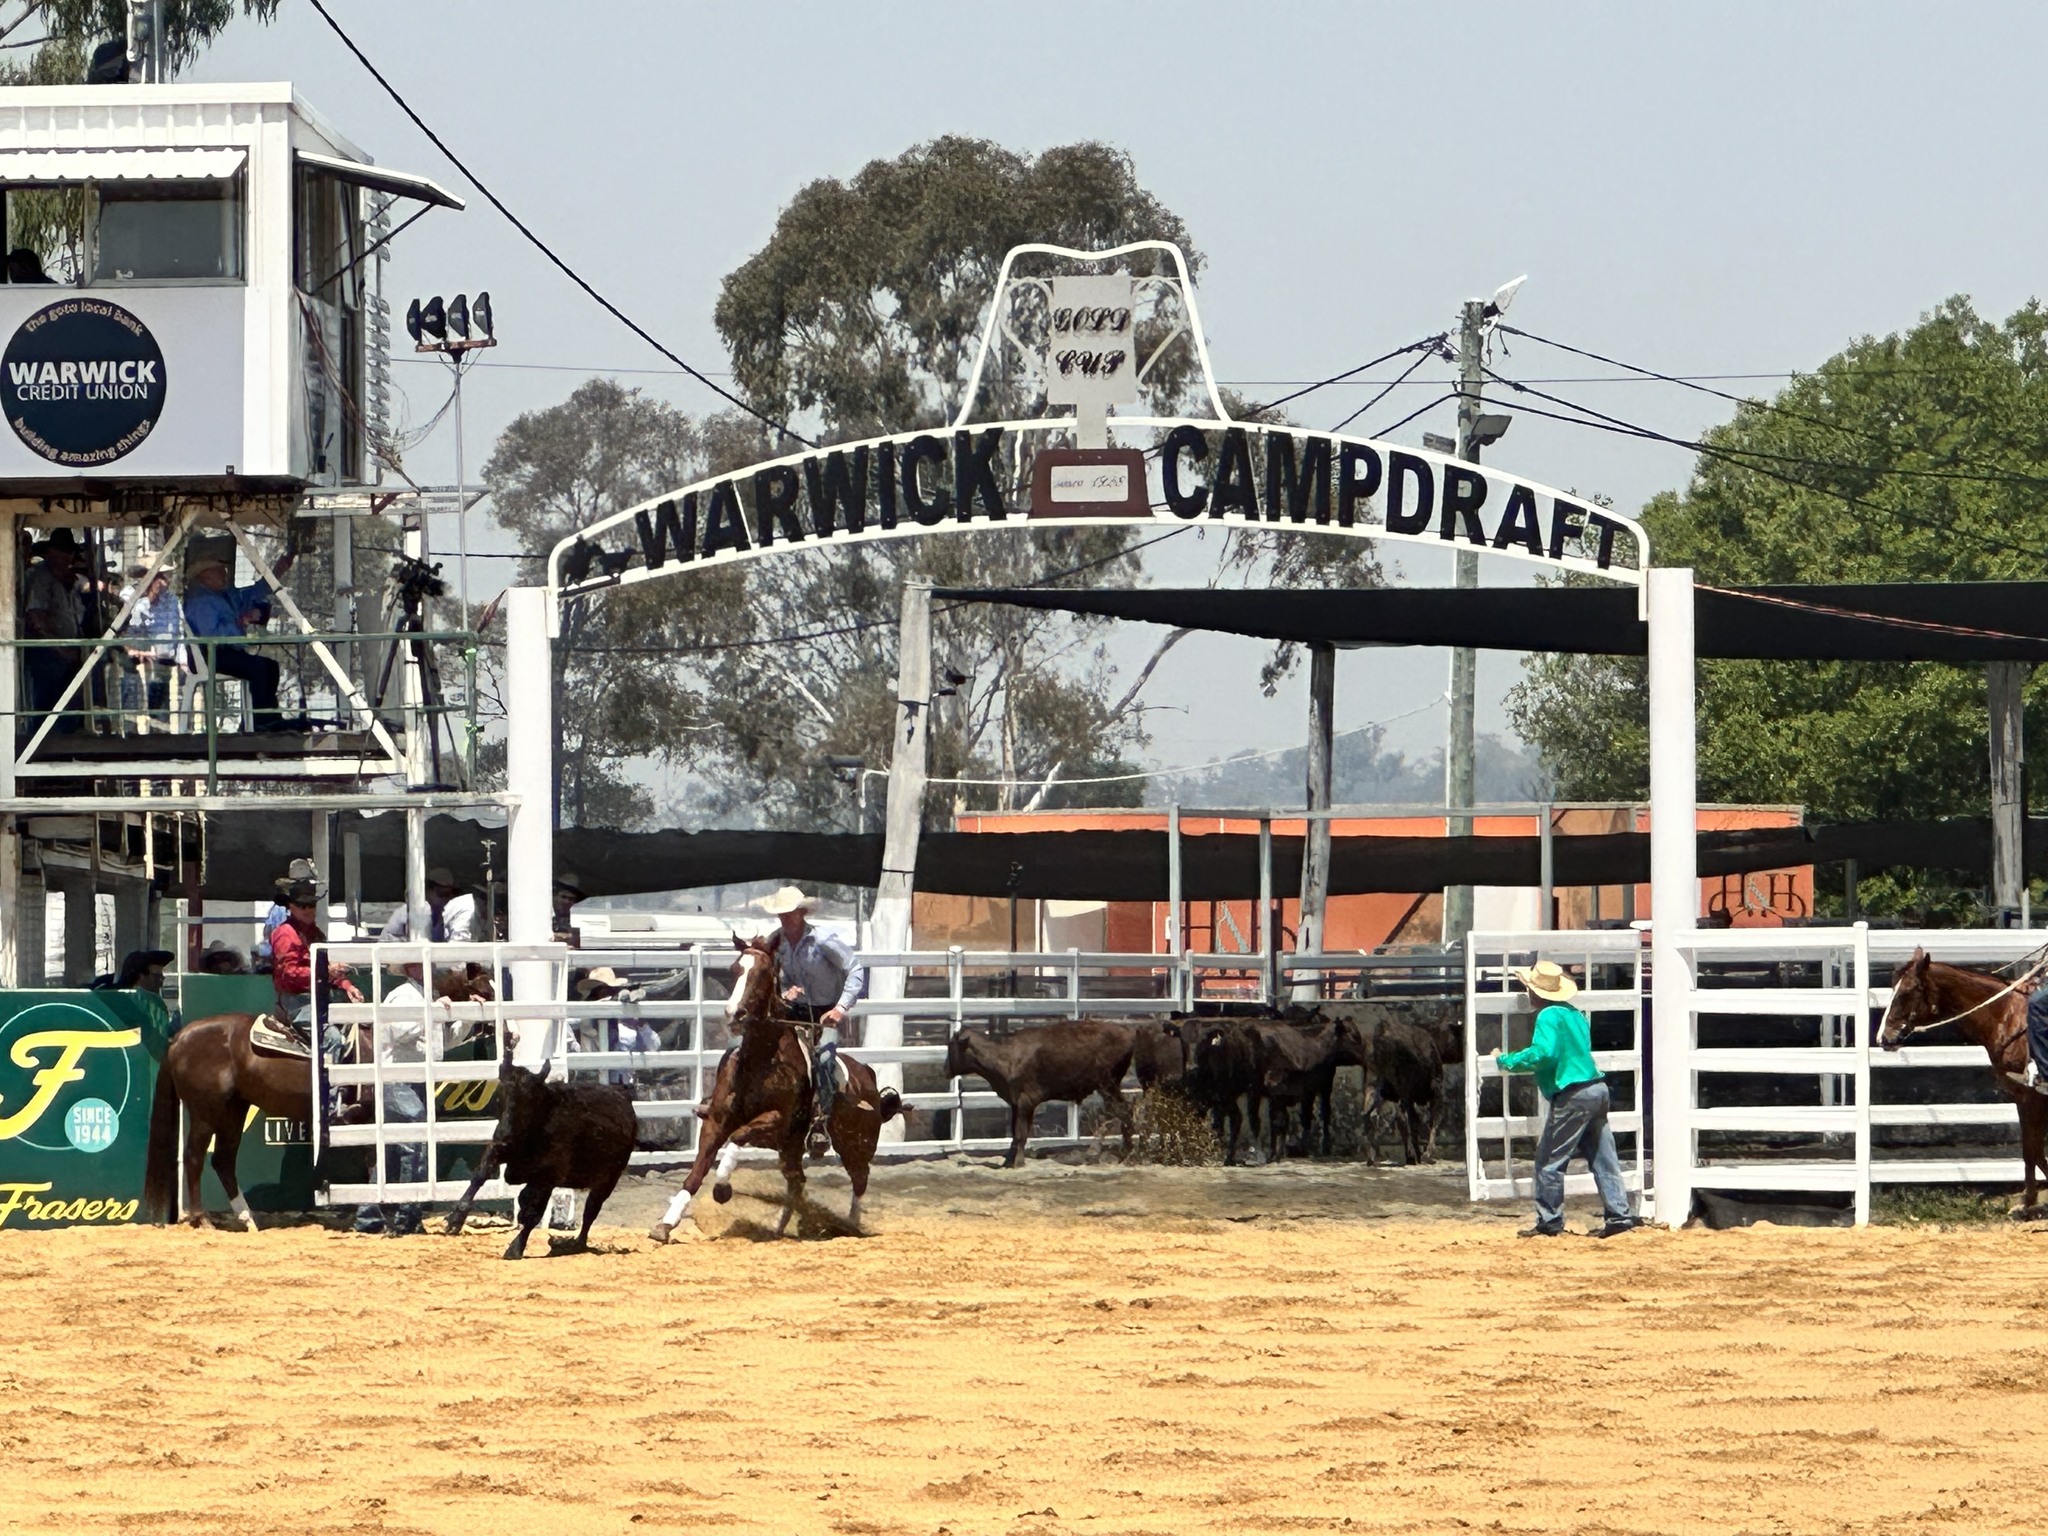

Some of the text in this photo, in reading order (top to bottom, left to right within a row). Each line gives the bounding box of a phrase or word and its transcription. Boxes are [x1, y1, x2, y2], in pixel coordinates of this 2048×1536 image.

[9, 360, 157, 385] WARWICK
[17, 383, 148, 401] CREDIT UNION
[635, 424, 1629, 570] WARWICK CAMPDRAFT
[73, 1106, 111, 1124] SINCE
[74, 1125, 111, 1144] 1944
[0, 1181, 139, 1227] Frasers
